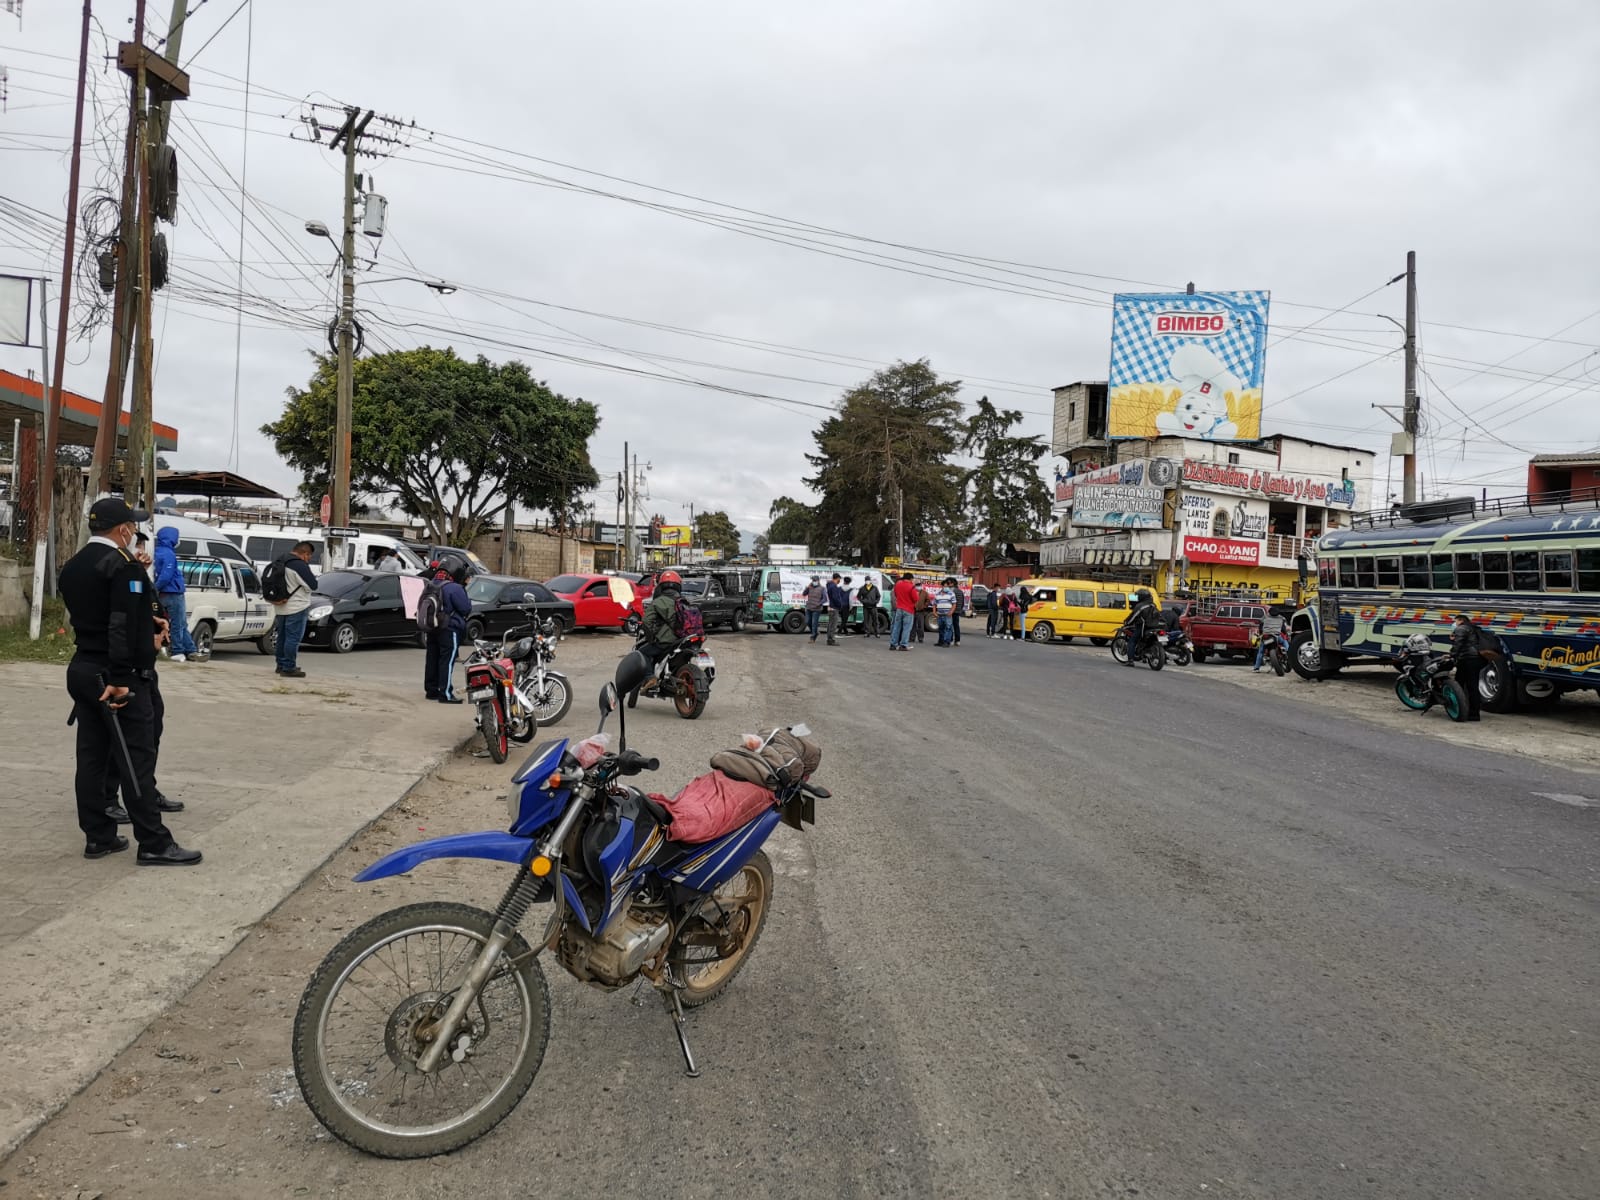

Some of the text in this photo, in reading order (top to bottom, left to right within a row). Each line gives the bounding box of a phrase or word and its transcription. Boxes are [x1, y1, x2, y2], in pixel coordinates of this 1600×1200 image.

[1157, 315, 1224, 331] BIMBO
[1250, 470, 1262, 490] de
[1295, 480, 1304, 500] y
[1303, 478, 1326, 499] Aros
[1145, 489, 1162, 500] 3D
[1075, 500, 1162, 513] BALANCEO COMPUTARIZADO
[1184, 495, 1211, 508] OFERTAS
[1187, 509, 1210, 520] LANTAS
[1193, 520, 1209, 529] AROS
[1186, 541, 1258, 557] CHAO YANG
